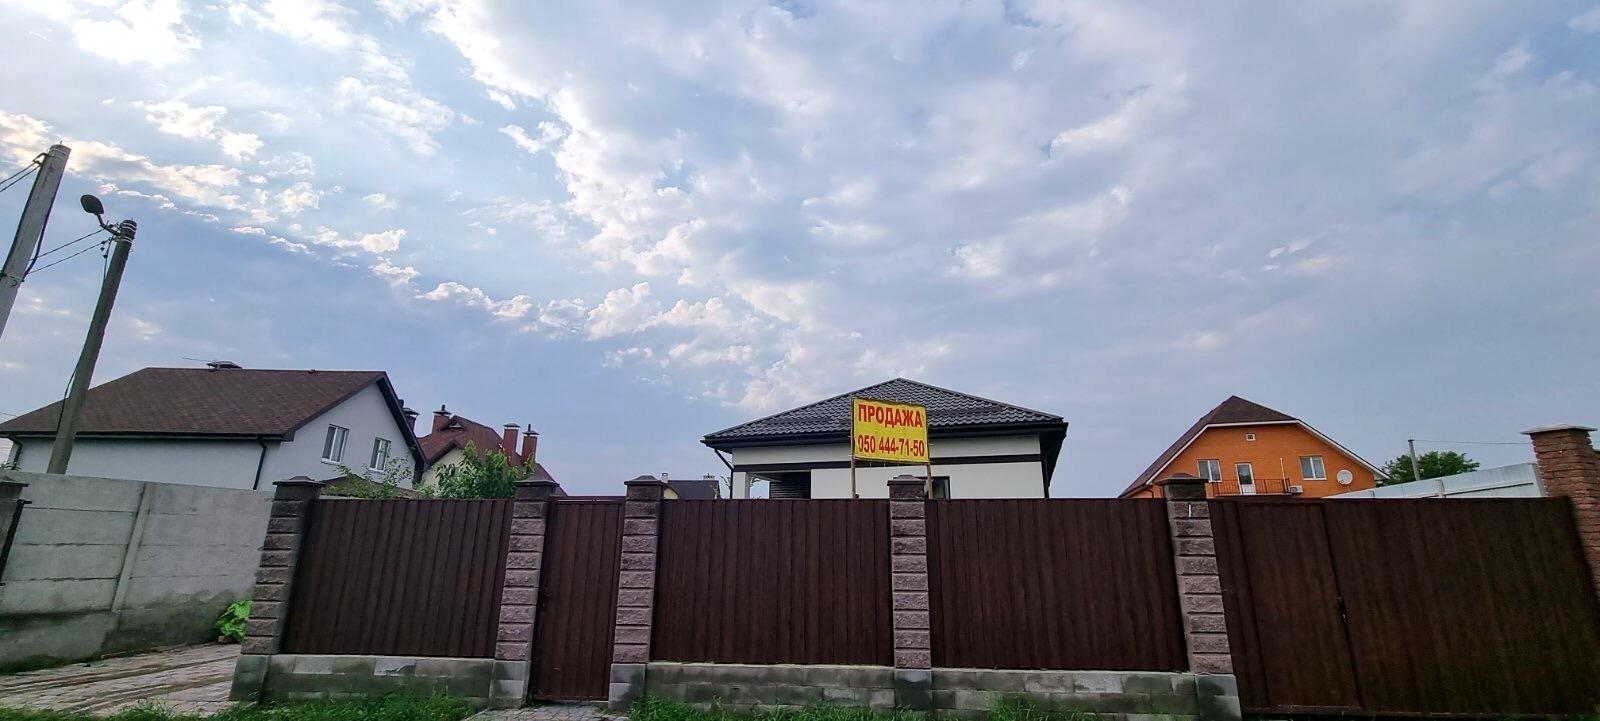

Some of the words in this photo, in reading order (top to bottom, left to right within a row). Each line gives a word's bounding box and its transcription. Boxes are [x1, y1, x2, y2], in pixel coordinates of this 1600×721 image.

[858, 404, 923, 428] ПРОДАЖА
[858, 435, 876, 453] 050
[879, 437, 925, 457] 444-71-50
